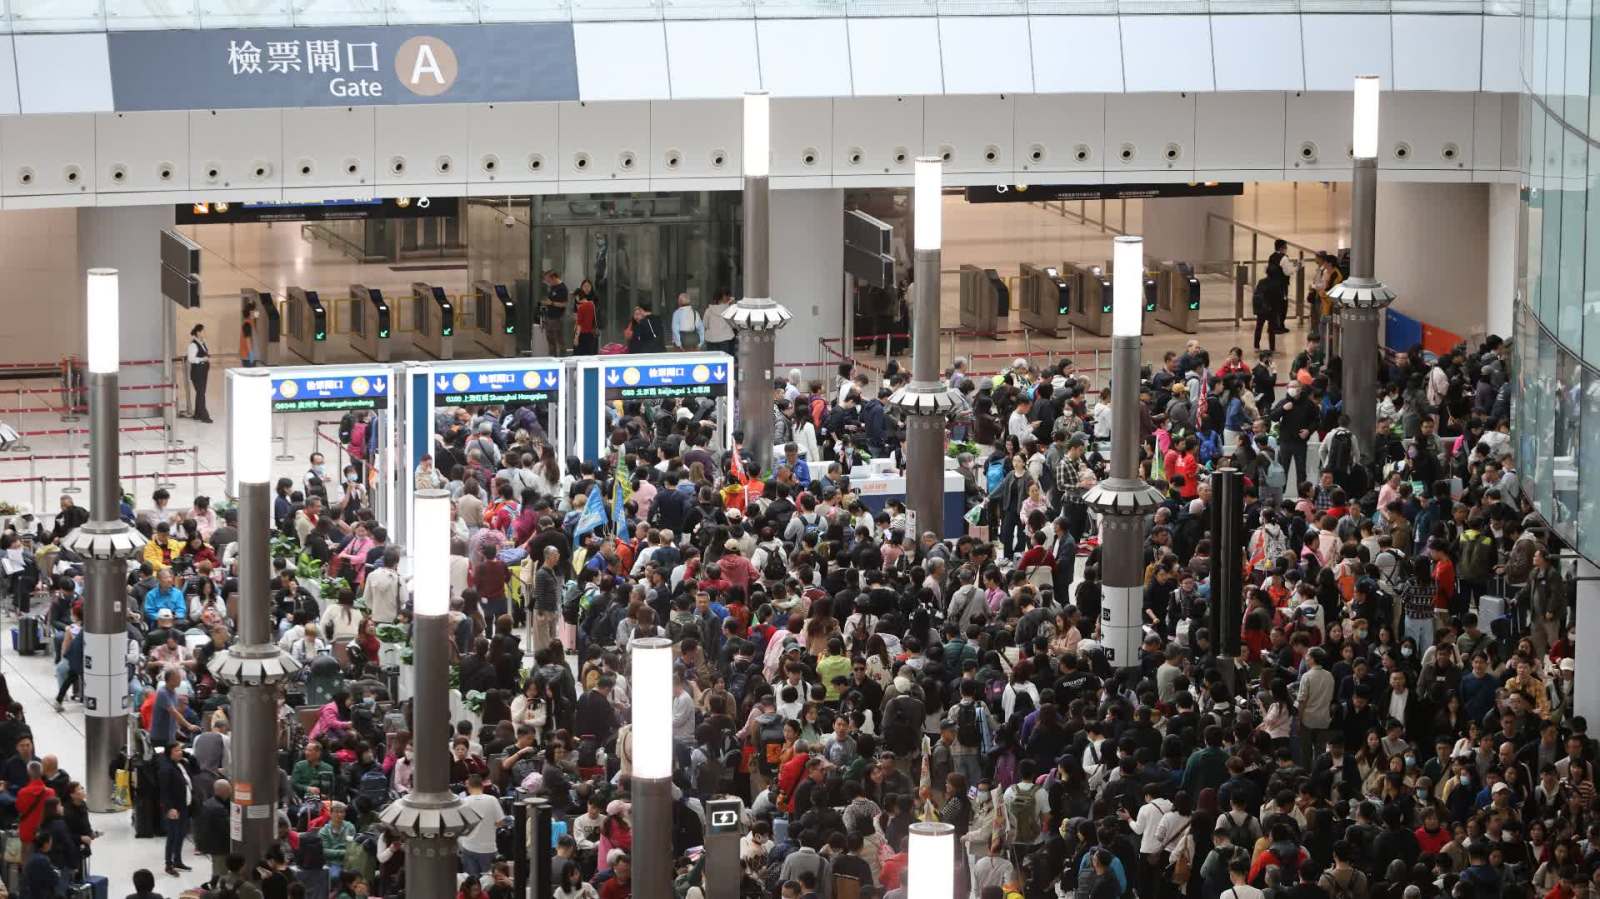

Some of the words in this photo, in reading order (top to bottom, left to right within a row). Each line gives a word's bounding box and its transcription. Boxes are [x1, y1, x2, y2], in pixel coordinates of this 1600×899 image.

[228, 39, 380, 75] 檢票閘口
[410, 45, 446, 84] A
[329, 78, 382, 97] Gate
